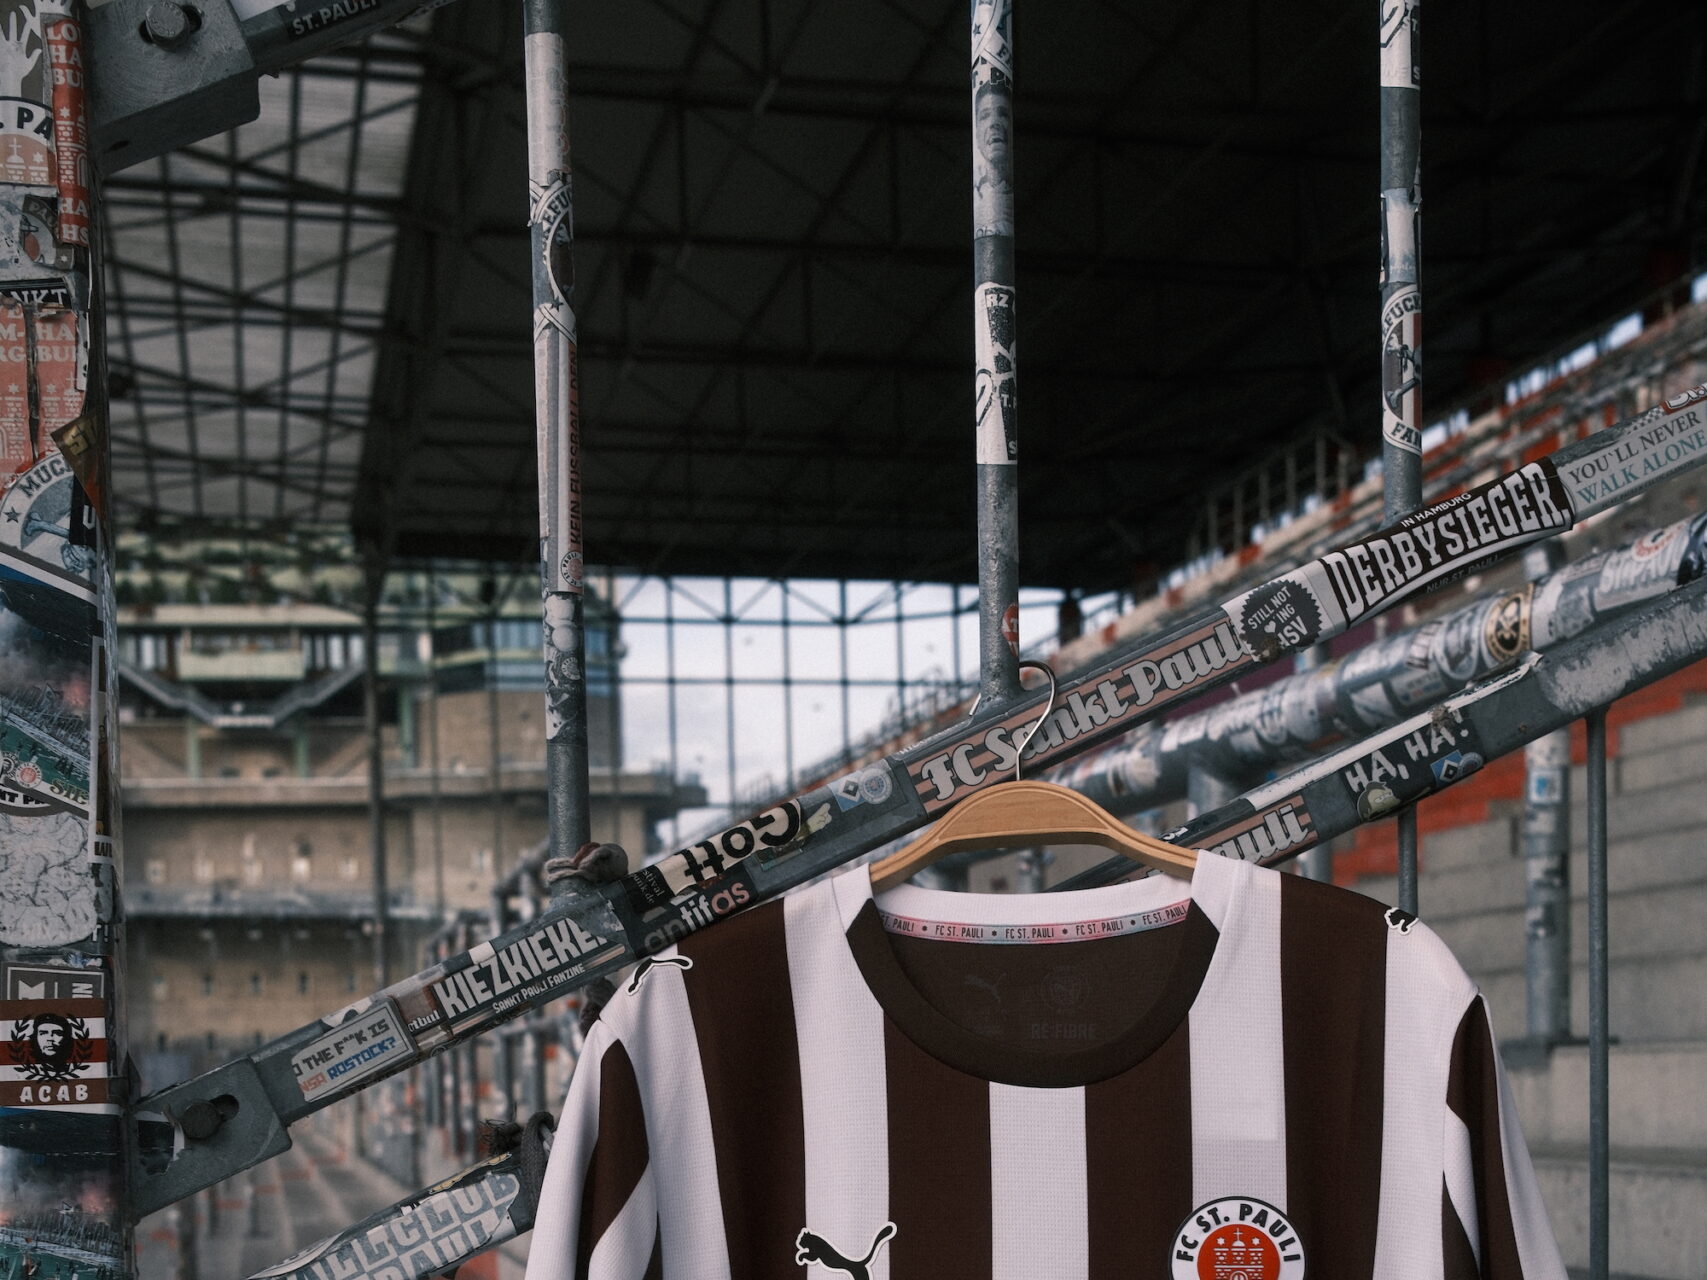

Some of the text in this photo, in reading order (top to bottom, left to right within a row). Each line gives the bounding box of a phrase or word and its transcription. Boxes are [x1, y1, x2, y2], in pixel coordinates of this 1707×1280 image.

[1640, 410, 1702, 451] NEVER
[1577, 463, 1640, 505] WALK
[1401, 492, 1472, 528] IN HAMBURG
[1248, 586, 1292, 630] STILL NOT
[643, 881, 750, 953] antifas
[892, 918, 915, 932] PAULI
[935, 924, 984, 938] FC ST. PAULI
[1005, 927, 1055, 939] FC ST. PAULI
[1075, 919, 1124, 936] FC ST. PAULI
[1142, 905, 1187, 925] FC ST. PAULI
[492, 993, 522, 1014] SANKT
[302, 1047, 335, 1070] THE
[368, 1019, 390, 1038] IS
[326, 1036, 396, 1080] ROSTOCK?
[20, 1084, 89, 1103] ACAB
[1176, 1203, 1302, 1262] FC ST. PAULI
